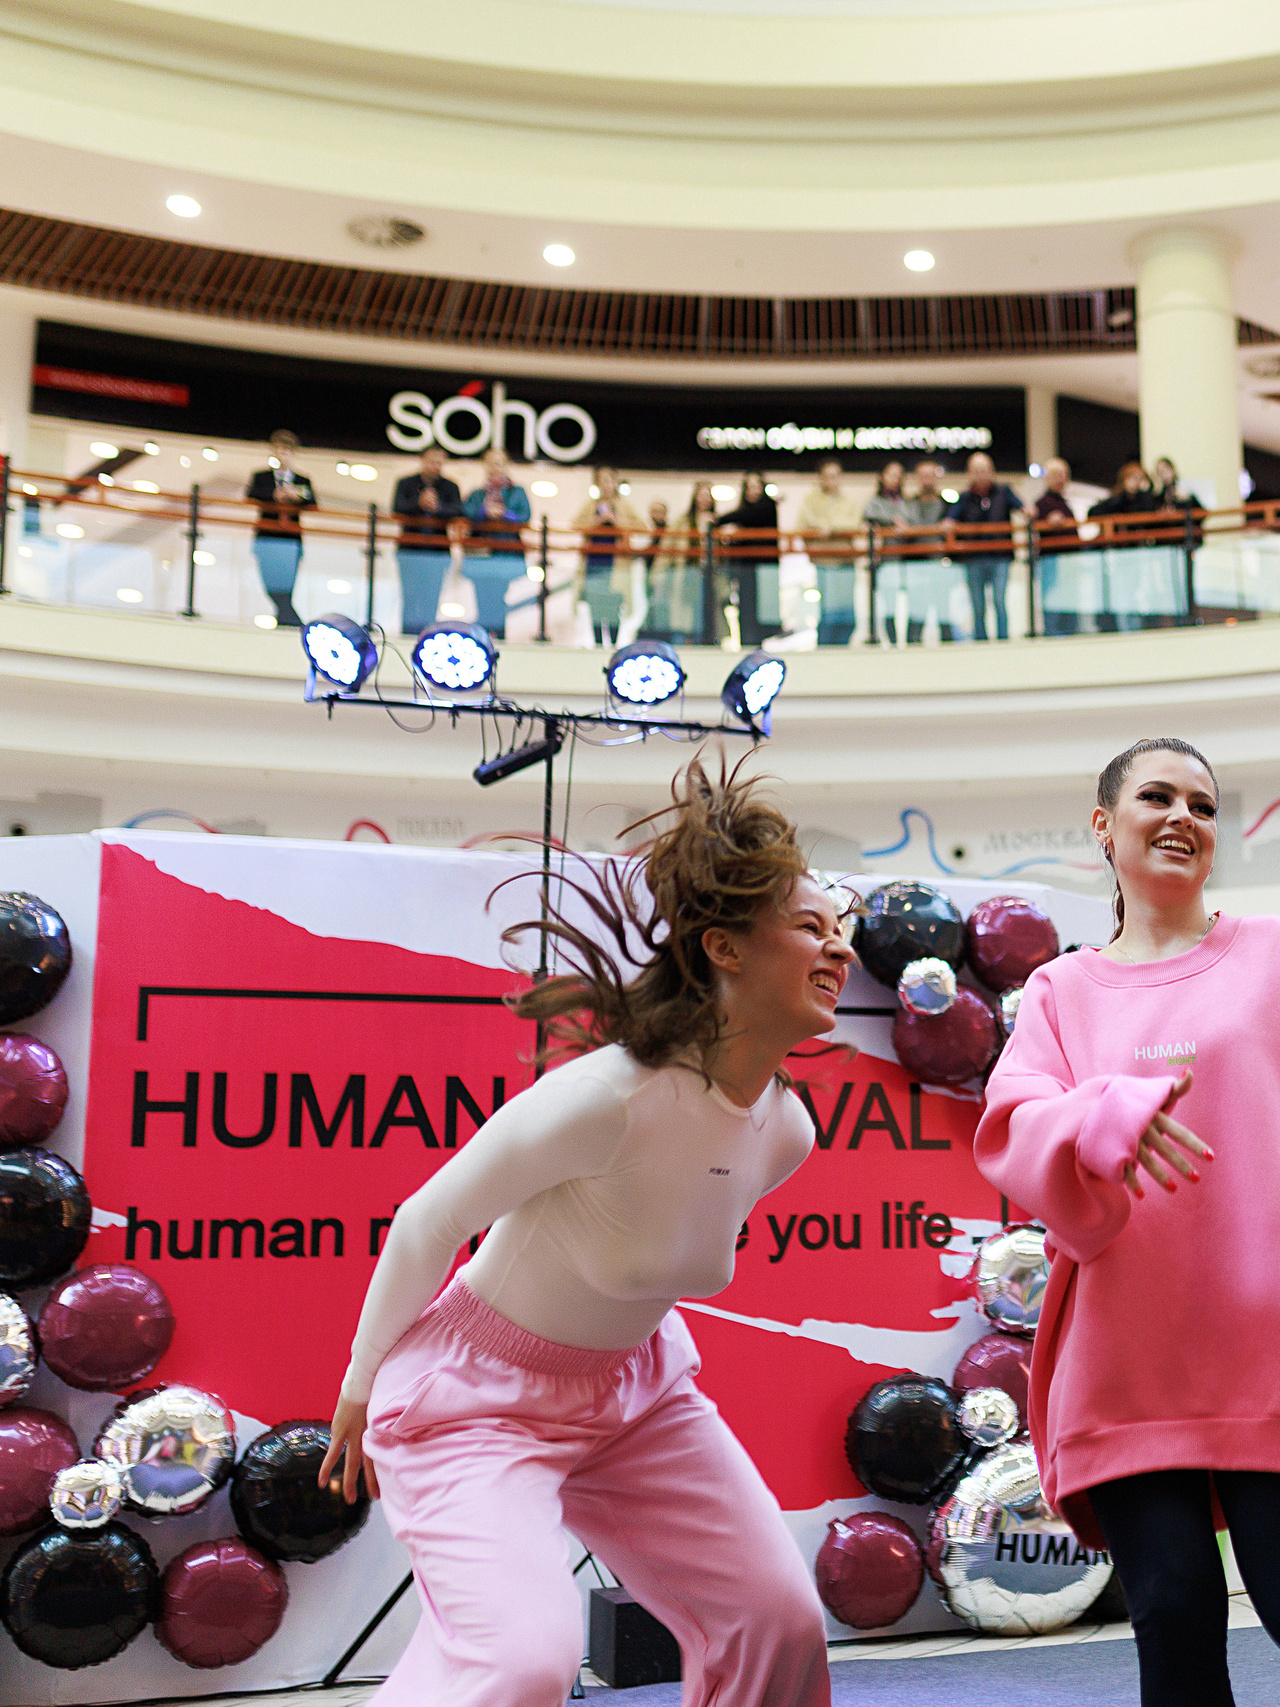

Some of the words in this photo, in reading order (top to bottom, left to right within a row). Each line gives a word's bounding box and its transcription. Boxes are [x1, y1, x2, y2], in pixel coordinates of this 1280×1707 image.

[1134, 1041, 1197, 1060] HUMAN
[1167, 1055, 1196, 1066] RIGHT
[131, 1071, 506, 1149] HUMAN
[124, 1206, 345, 1260] human
[766, 1213, 863, 1264] you
[881, 1201, 953, 1250] life
